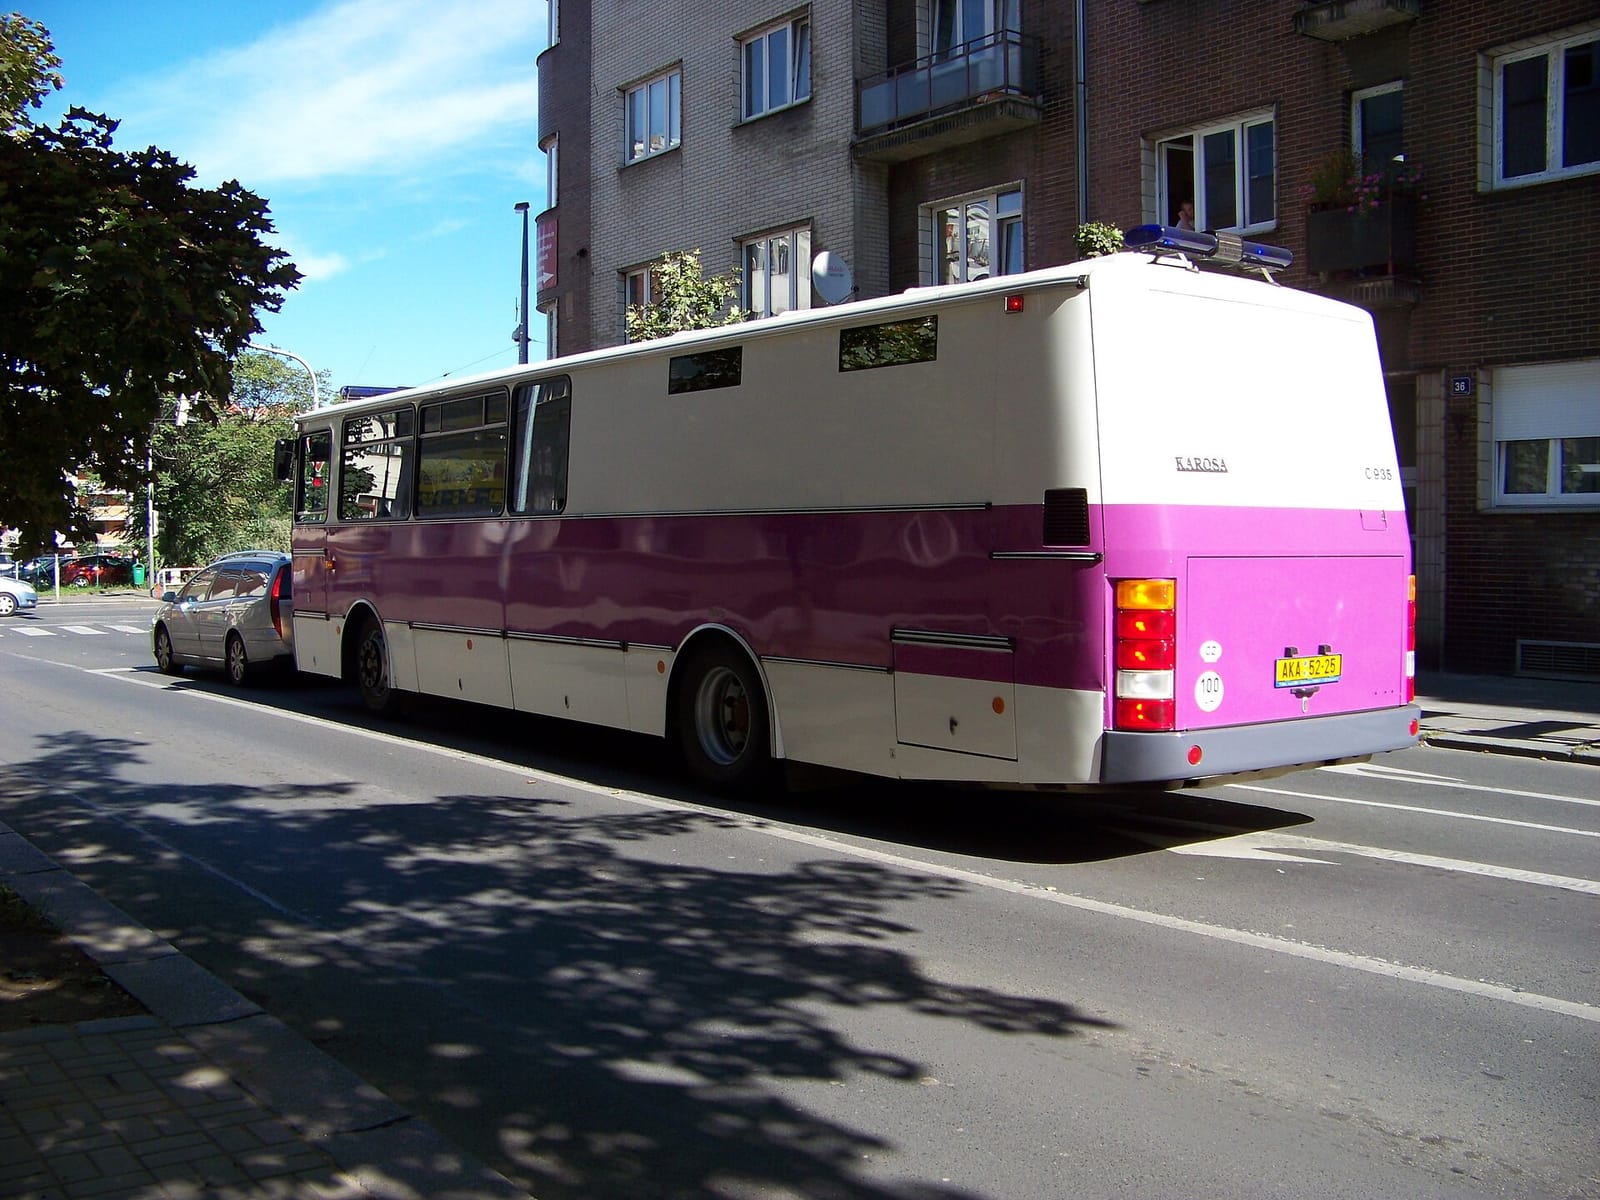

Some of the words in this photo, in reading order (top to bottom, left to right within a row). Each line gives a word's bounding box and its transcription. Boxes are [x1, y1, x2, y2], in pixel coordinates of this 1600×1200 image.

[1454, 381, 1466, 392] 36
[1175, 456, 1229, 473] KAROSA
[1373, 468, 1392, 481] 935
[1281, 661, 1301, 678] AKA
[1201, 677, 1220, 694] 100
